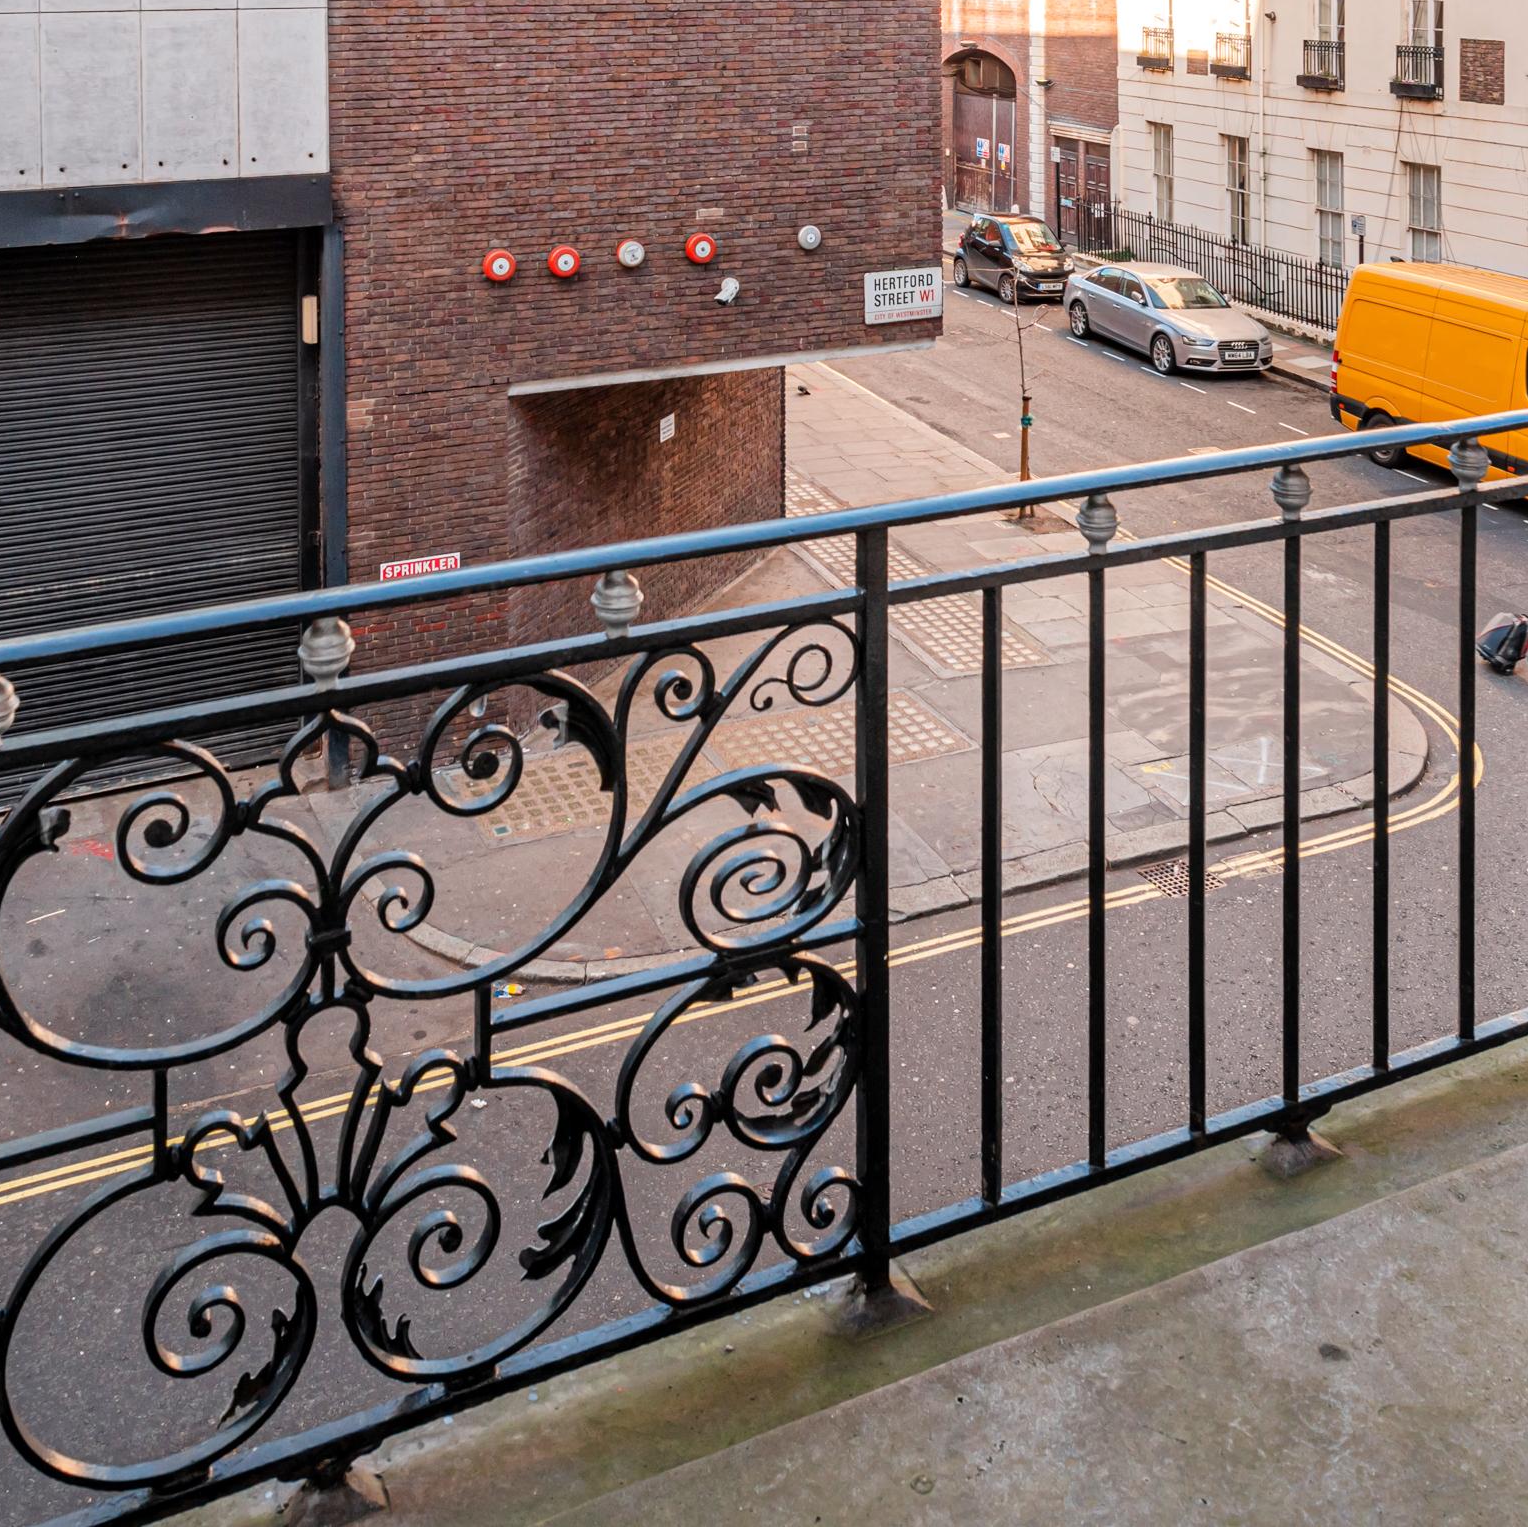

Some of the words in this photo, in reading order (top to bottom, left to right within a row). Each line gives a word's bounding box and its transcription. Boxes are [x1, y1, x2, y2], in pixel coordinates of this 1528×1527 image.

[874, 273, 933, 291] HERTFORD
[874, 291, 915, 307] STREET
[919, 289, 935, 303] W1
[874, 313, 886, 321] CITY
[895, 308, 932, 319] WESTMINSTER
[385, 557, 456, 578] SPRINKLER
